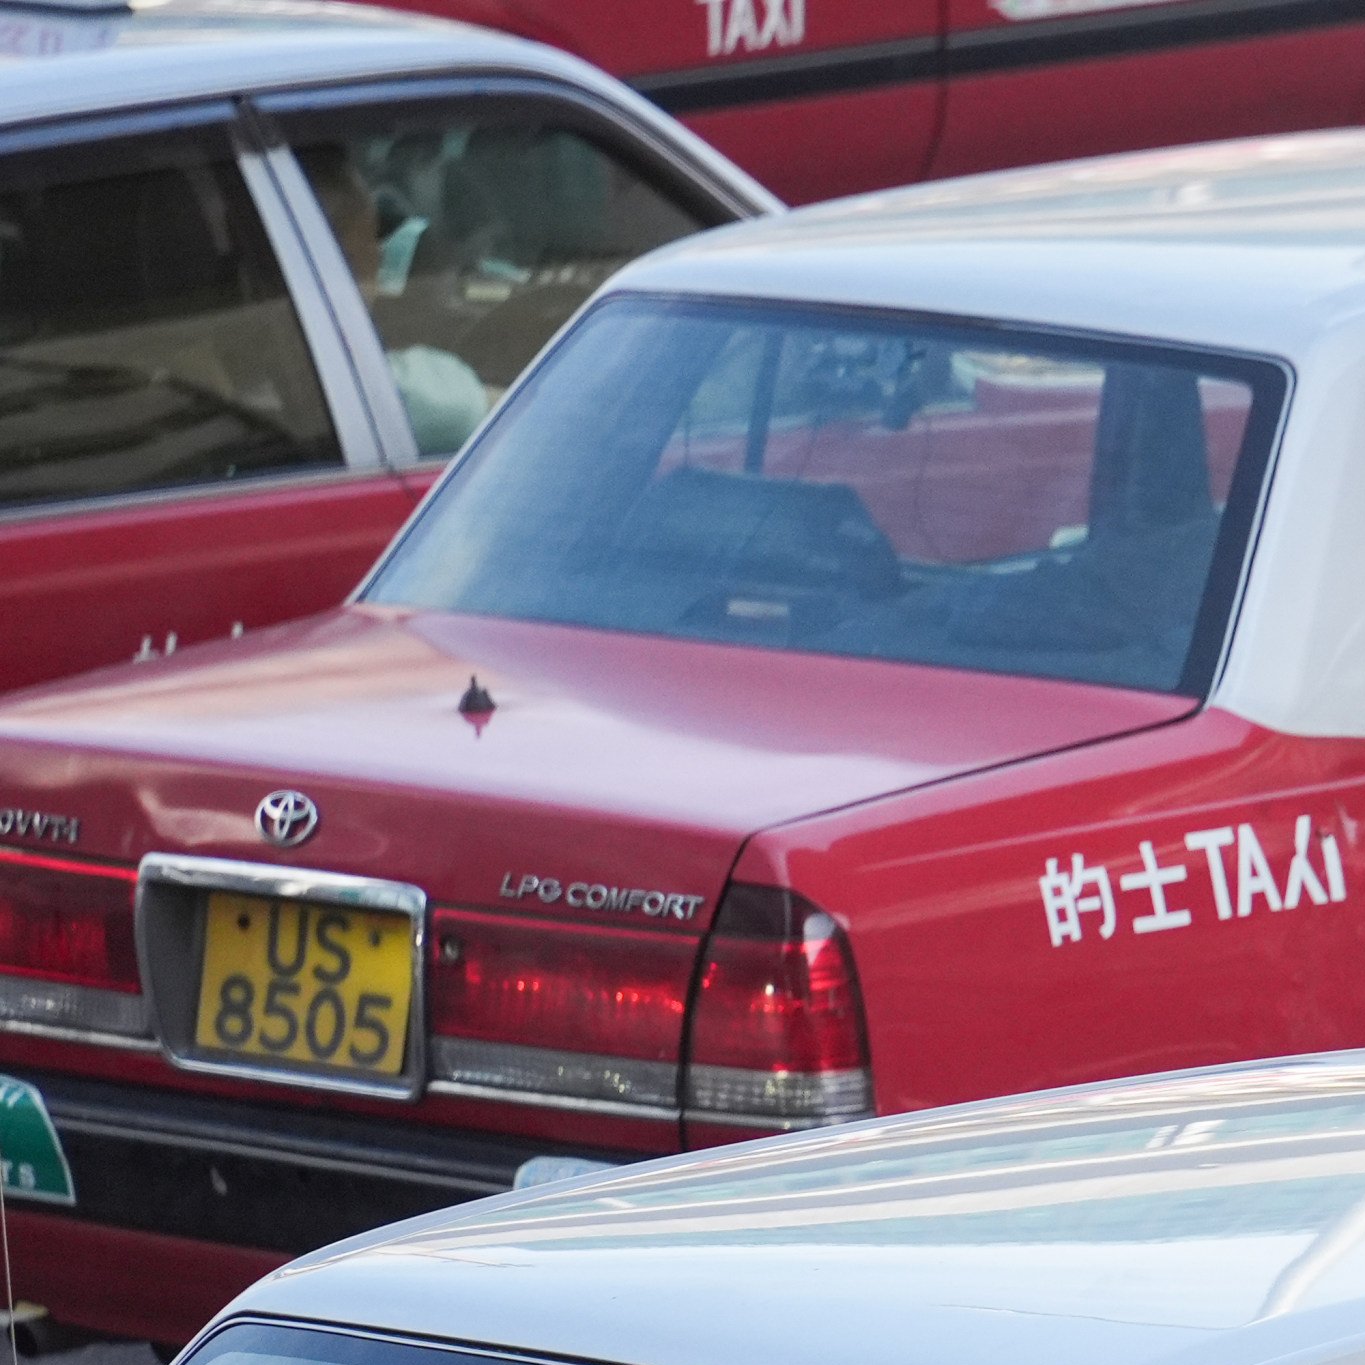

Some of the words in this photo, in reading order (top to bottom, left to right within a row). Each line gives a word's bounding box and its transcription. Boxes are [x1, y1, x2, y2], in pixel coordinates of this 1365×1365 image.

[500, 871, 562, 903] LPG
[567, 882, 704, 920] COMFORT
[1039, 843, 1192, 947] 的士
[267, 897, 352, 985] US
[215, 973, 392, 1066] 8505
